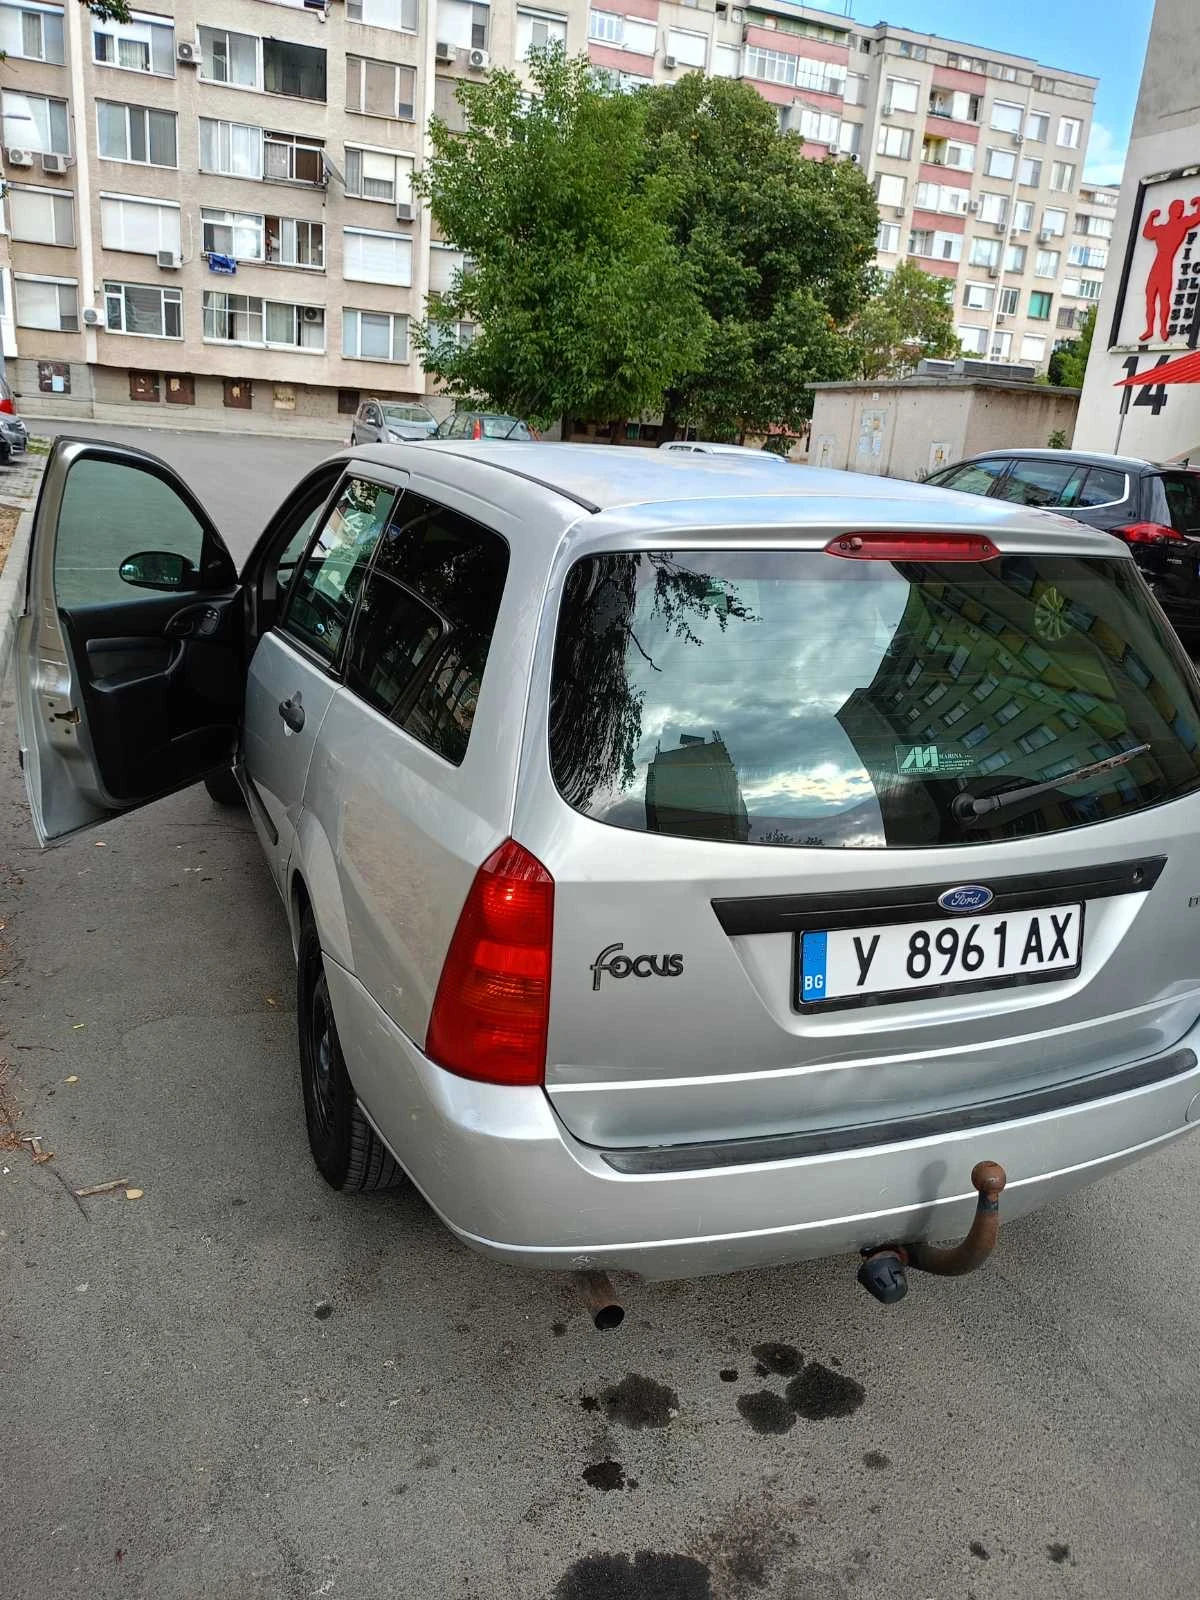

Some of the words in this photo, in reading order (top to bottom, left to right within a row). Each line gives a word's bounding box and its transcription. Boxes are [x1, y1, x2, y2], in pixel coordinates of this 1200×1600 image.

[1168, 231, 1198, 336] FITNESS
[1119, 354, 1171, 416] 14
[951, 890, 981, 906] Ford
[852, 934, 881, 987] Y
[906, 920, 1008, 979] 8961
[1020, 912, 1073, 966] AX
[804, 974, 824, 991] BG
